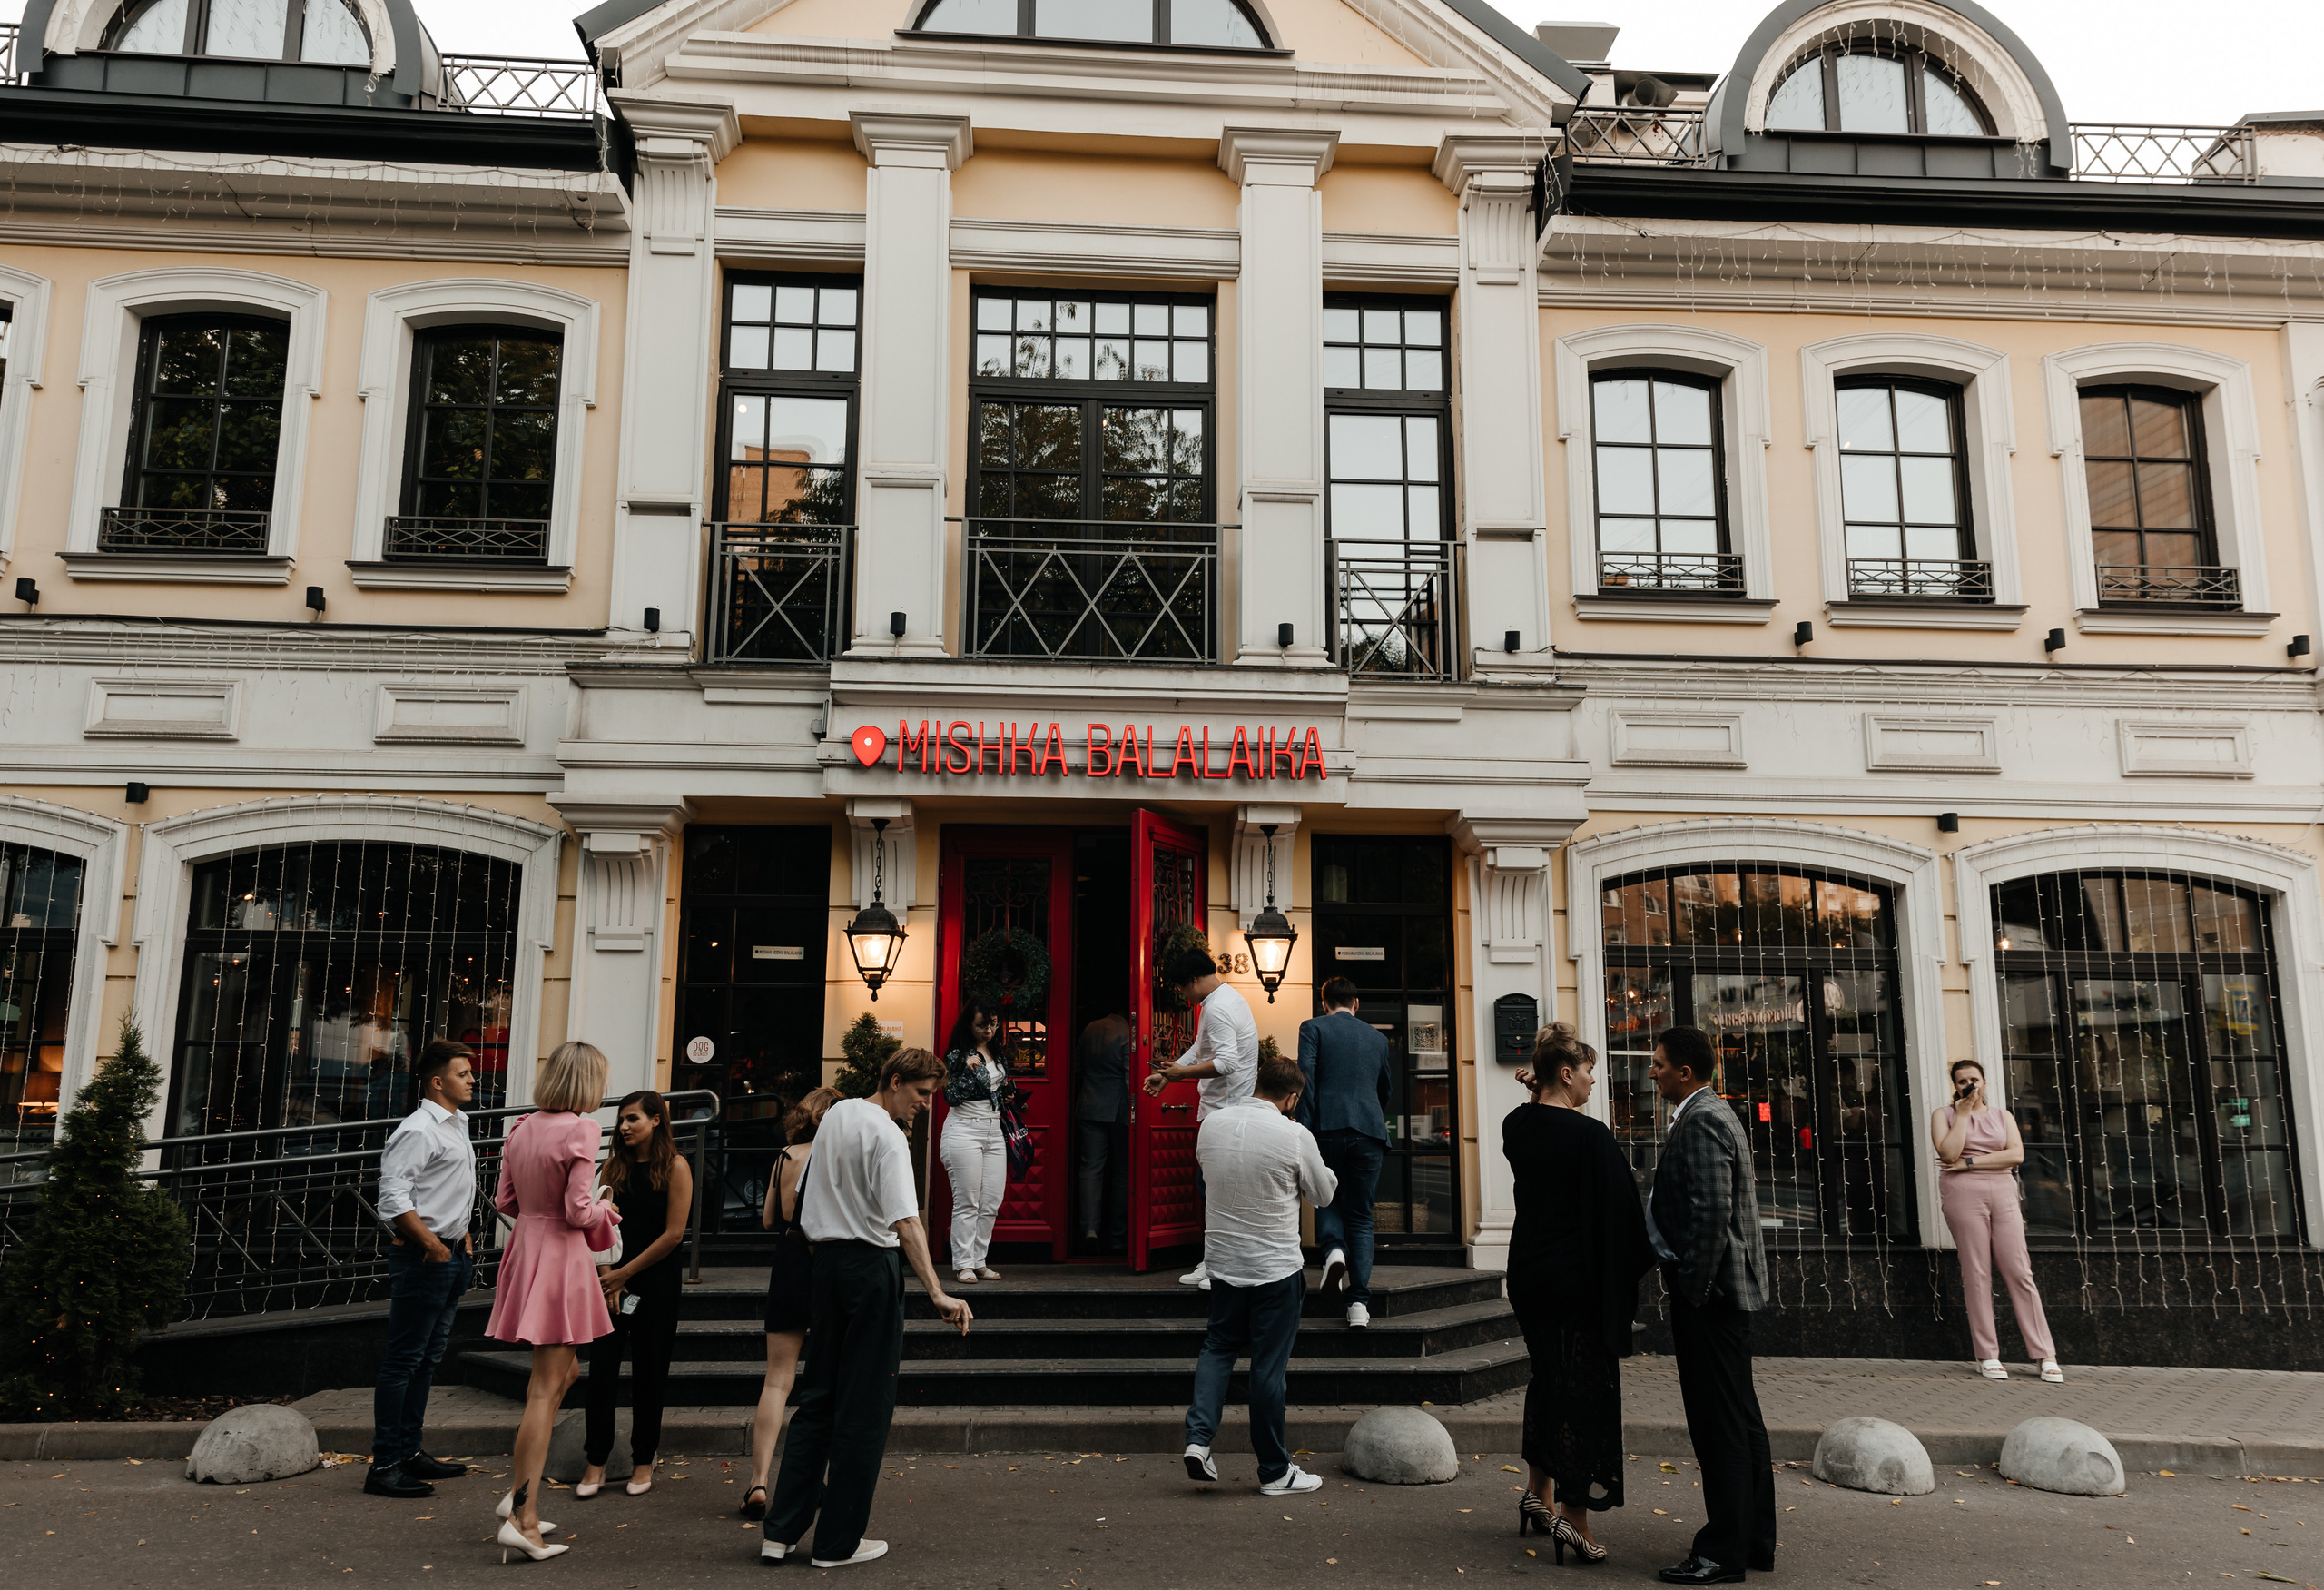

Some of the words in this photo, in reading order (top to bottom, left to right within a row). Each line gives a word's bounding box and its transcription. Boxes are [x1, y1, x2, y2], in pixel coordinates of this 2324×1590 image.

[898, 719, 1068, 776] MISHKA
[1086, 723, 1328, 780] BALALAIKA
[1217, 953, 1250, 974] 38
[693, 1041, 709, 1052] DOG
